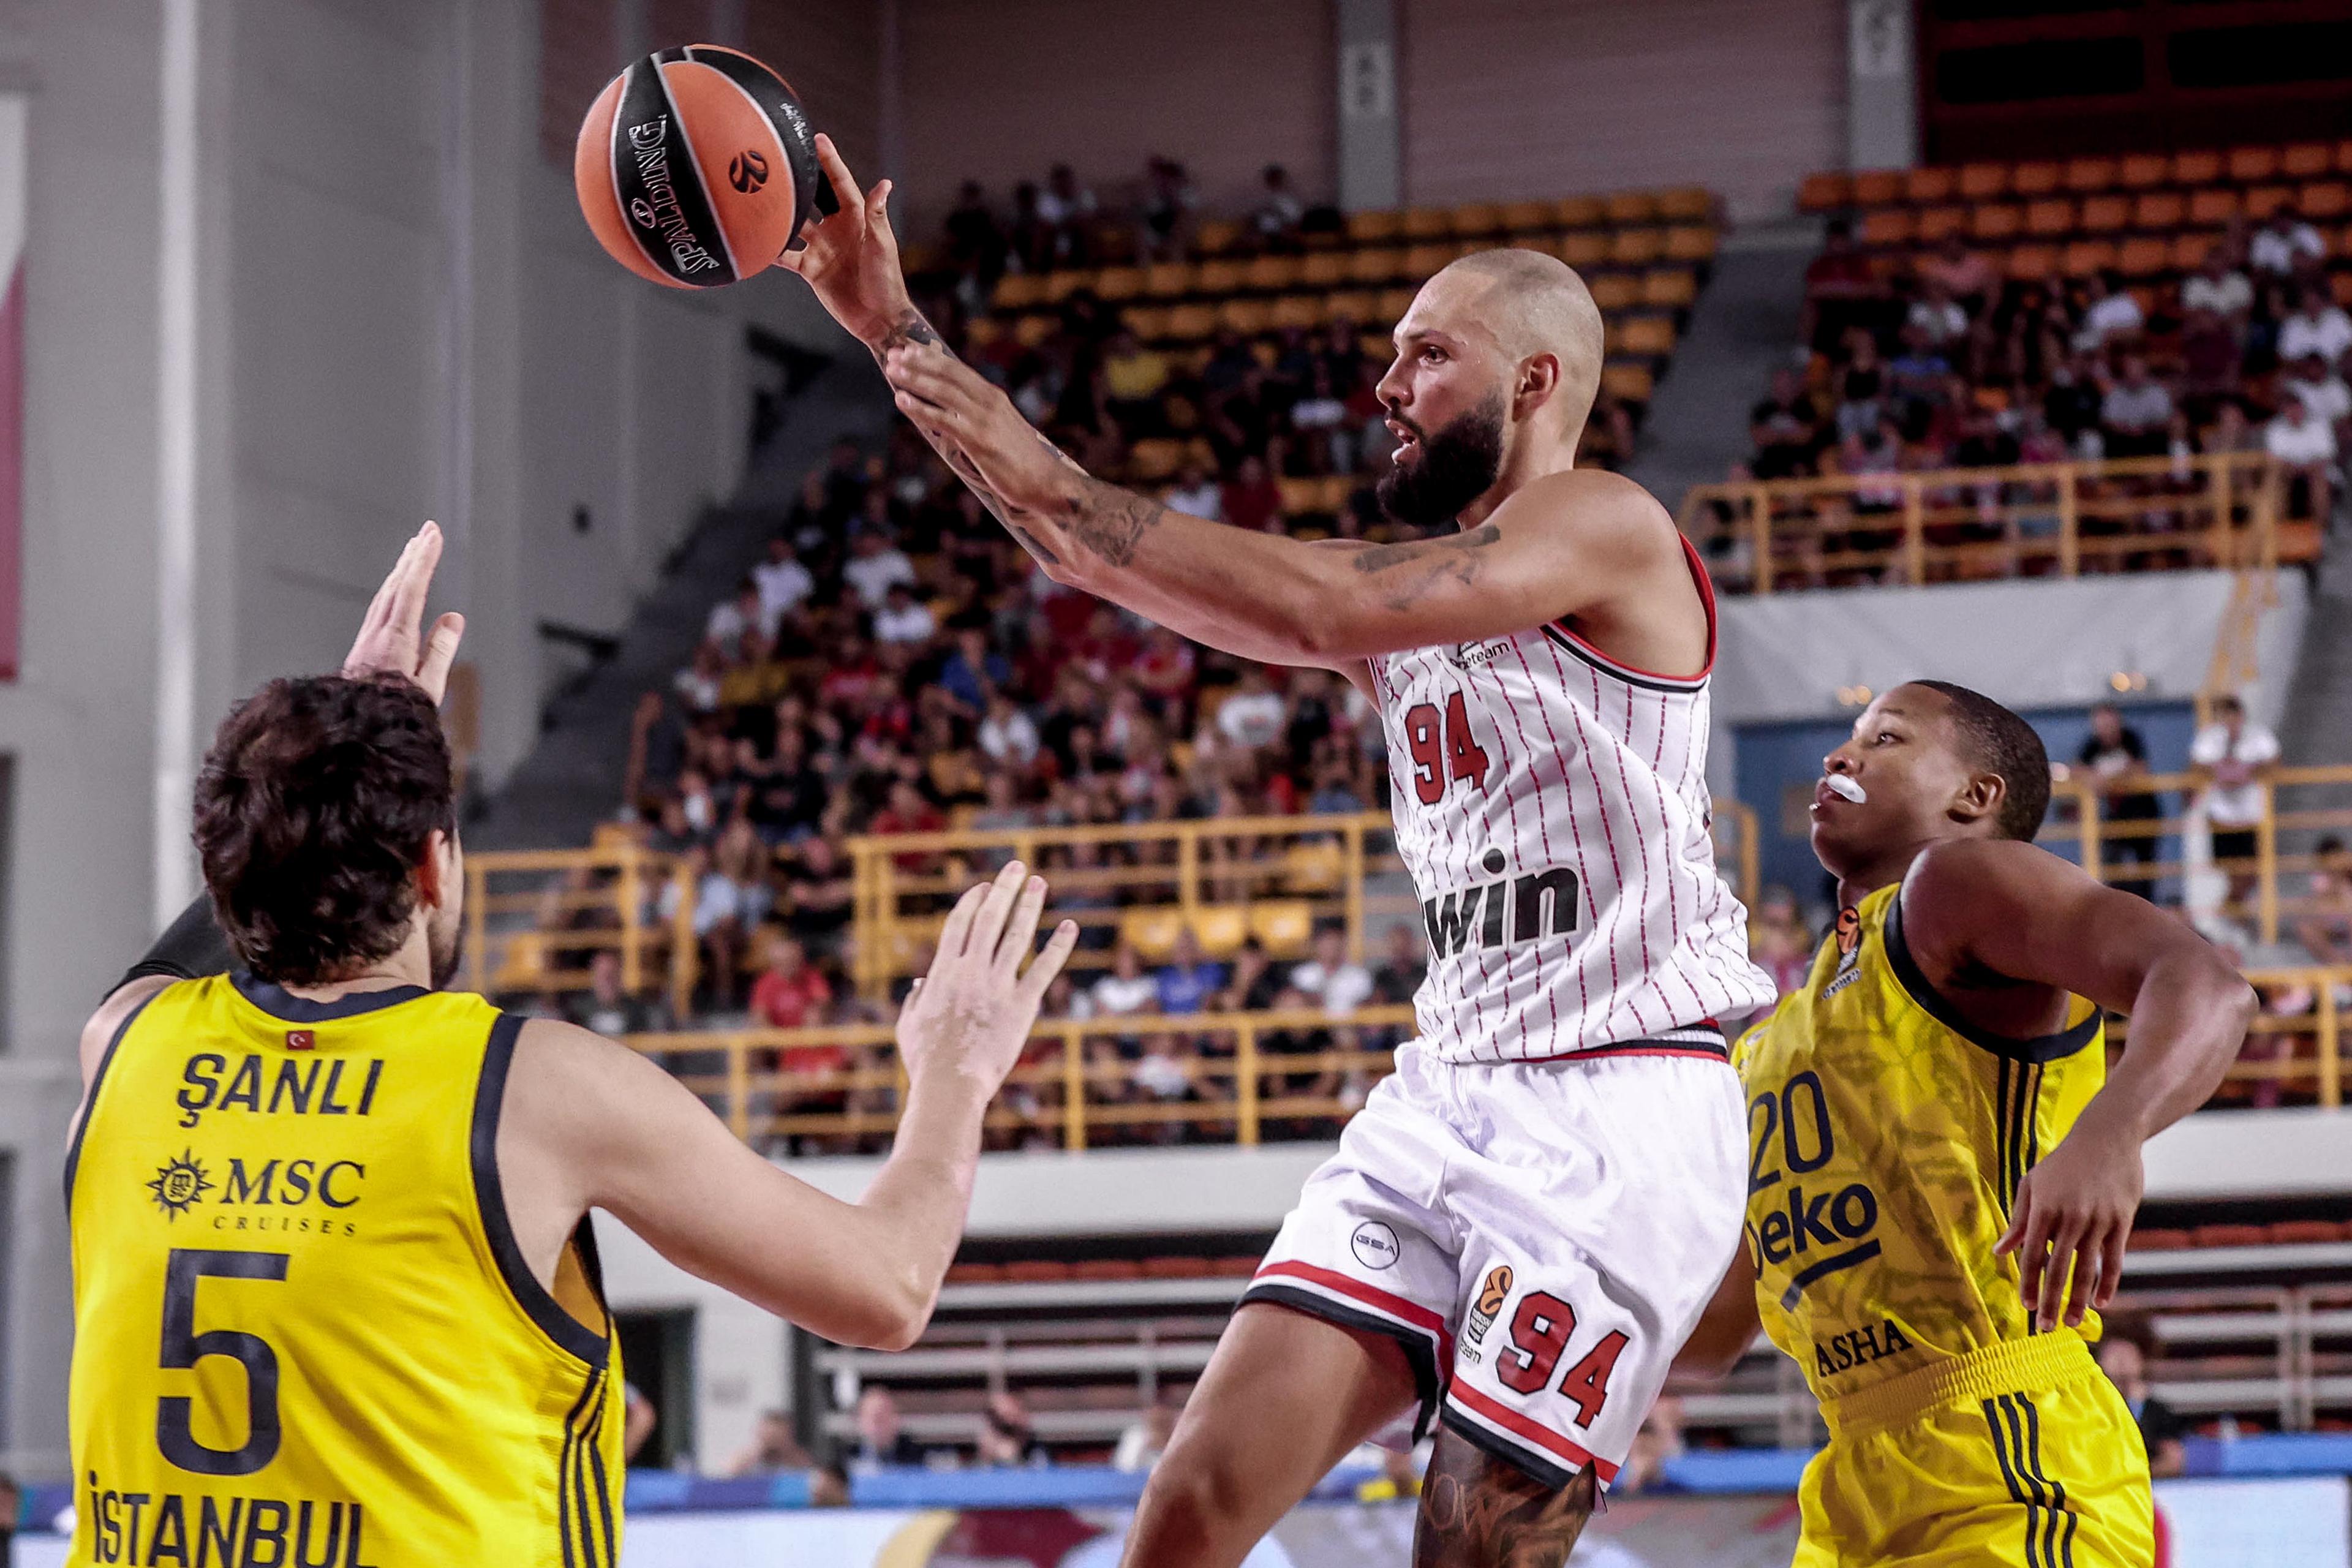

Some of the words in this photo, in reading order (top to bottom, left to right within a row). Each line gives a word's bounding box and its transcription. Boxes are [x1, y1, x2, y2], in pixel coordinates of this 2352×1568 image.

[628, 119, 720, 274] SPALDING
[1405, 691, 1489, 805] 94
[177, 1053, 384, 1128] ŞANLI
[1748, 1070, 1834, 1194] 20
[213, 1216, 355, 1237] CRUISES
[219, 1158, 366, 1208] MSC
[1356, 1234, 1395, 1256] GSA
[154, 1248, 290, 1476] 5
[1496, 1291, 1630, 1430] 94
[1815, 1319, 1913, 1378] ASHA
